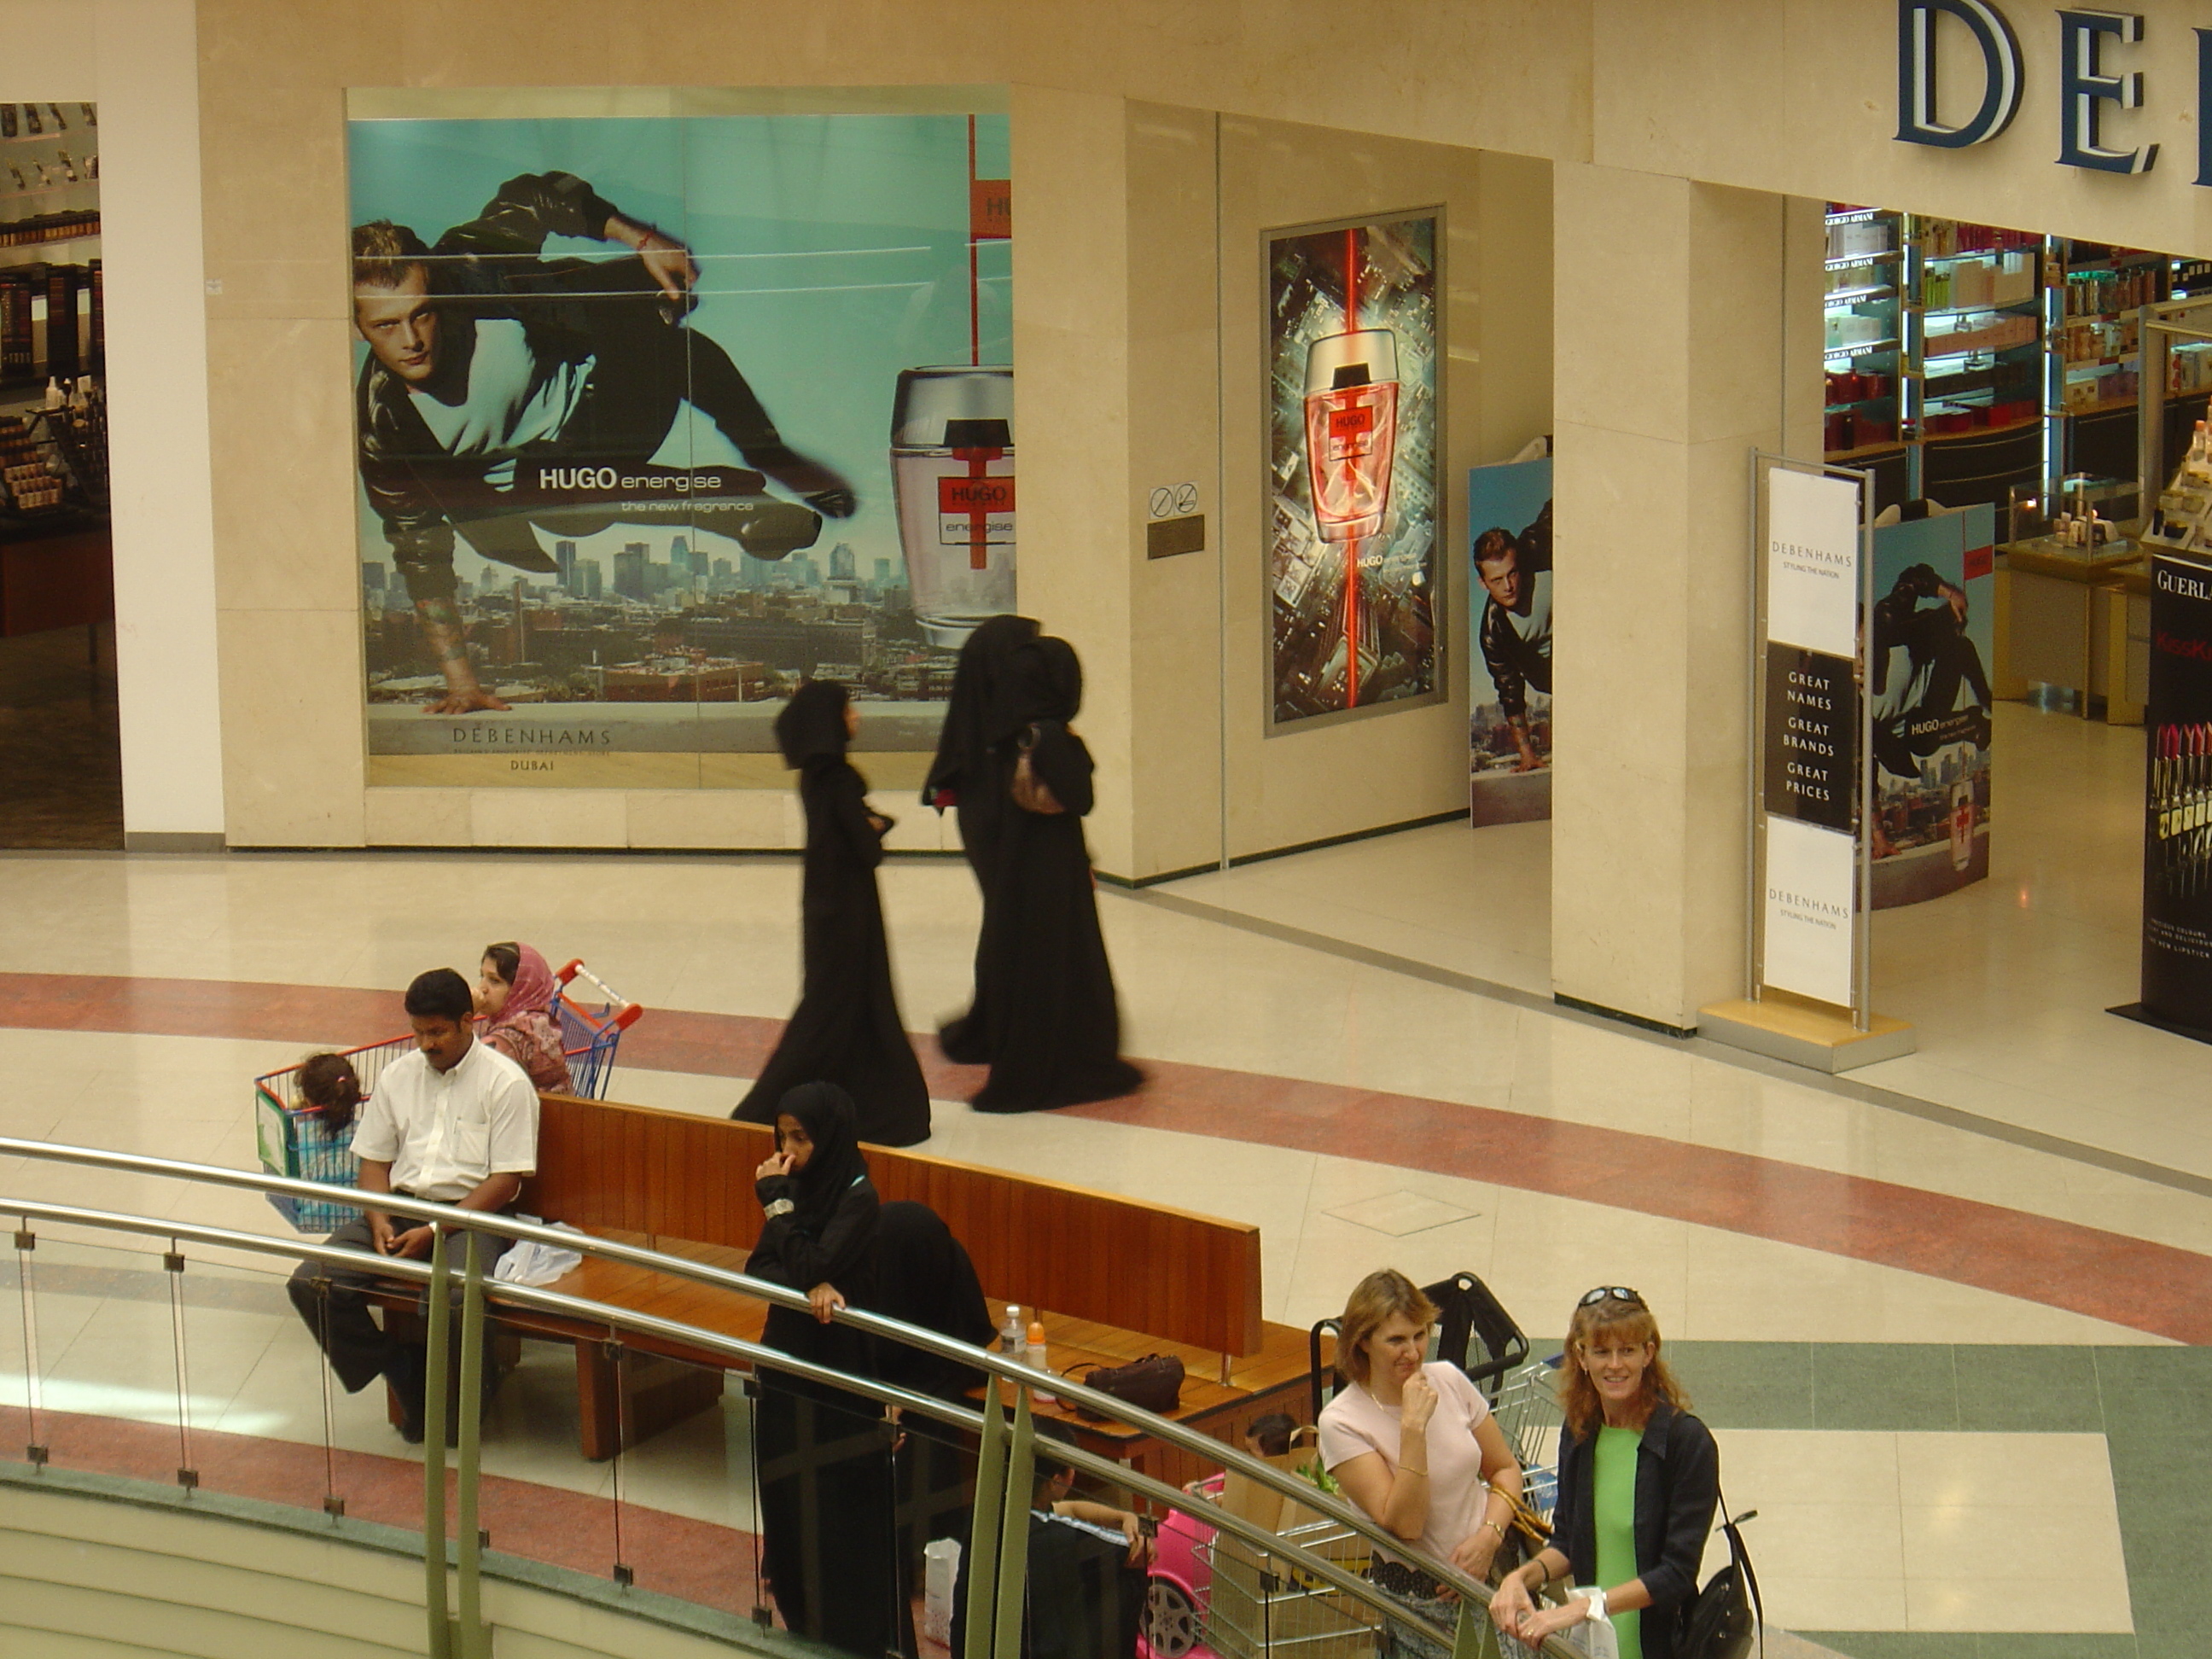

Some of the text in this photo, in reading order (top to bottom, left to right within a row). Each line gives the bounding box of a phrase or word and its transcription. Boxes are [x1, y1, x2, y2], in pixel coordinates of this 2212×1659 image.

[1892, 0, 2212, 186] DE
[1336, 414, 1365, 428] HUGO
[538, 467, 617, 489] HUGO
[952, 486, 1007, 502] HUGO
[621, 501, 645, 511] the
[682, 501, 754, 513] fragrance
[1356, 555, 1383, 568] HUGO
[1772, 541, 1852, 568] DEBENHAMS
[2157, 569, 2212, 601] GUERL
[1789, 671, 1830, 691] GREAT
[1787, 690, 1832, 711] NAMES
[453, 727, 611, 745] DEBENHAMS
[1788, 716, 1830, 736] GREAT
[1912, 719, 1939, 735] HUGO
[1783, 734, 1835, 757] BRANDS
[510, 760, 555, 771] DUBAI
[1787, 761, 1829, 782] GREAT
[1786, 780, 1831, 801] PRICES
[1769, 888, 1849, 919] DEBENHAMS
